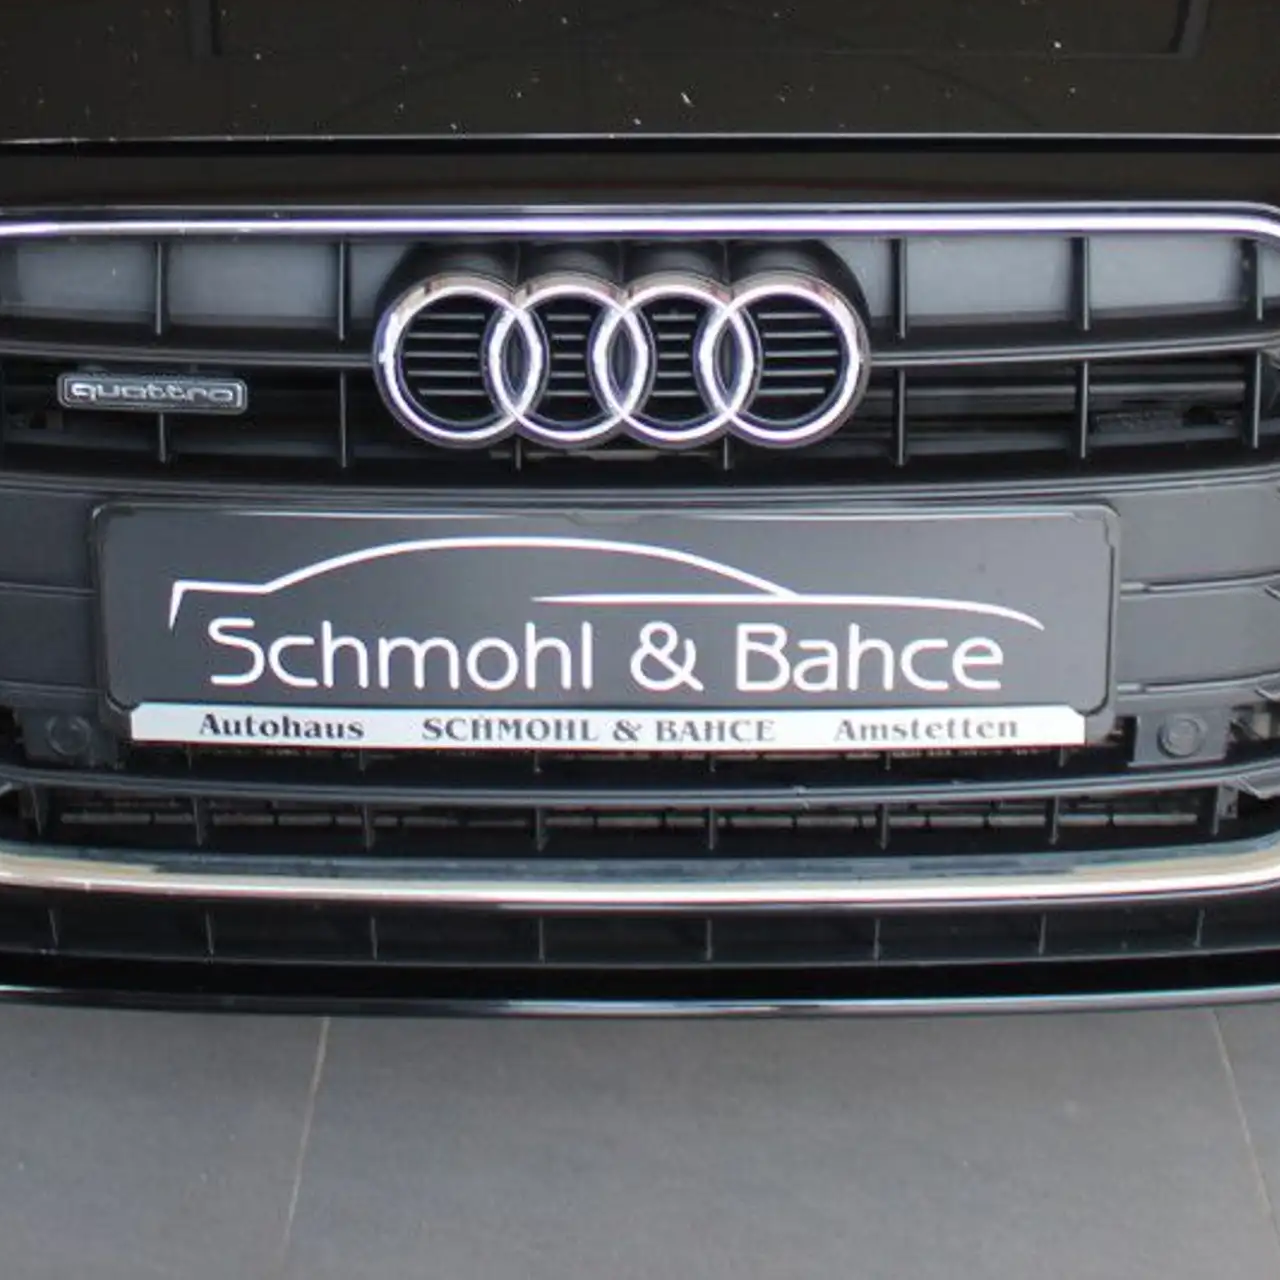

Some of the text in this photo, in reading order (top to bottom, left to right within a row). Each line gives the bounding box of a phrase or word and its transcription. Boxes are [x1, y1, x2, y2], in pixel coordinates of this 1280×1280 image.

[70, 382, 234, 403] quattro
[207, 617, 1005, 693] Schmohl & Bahce
[199, 712, 1020, 743] Autohaus SCHMOHL & BAHCE Amstetten
